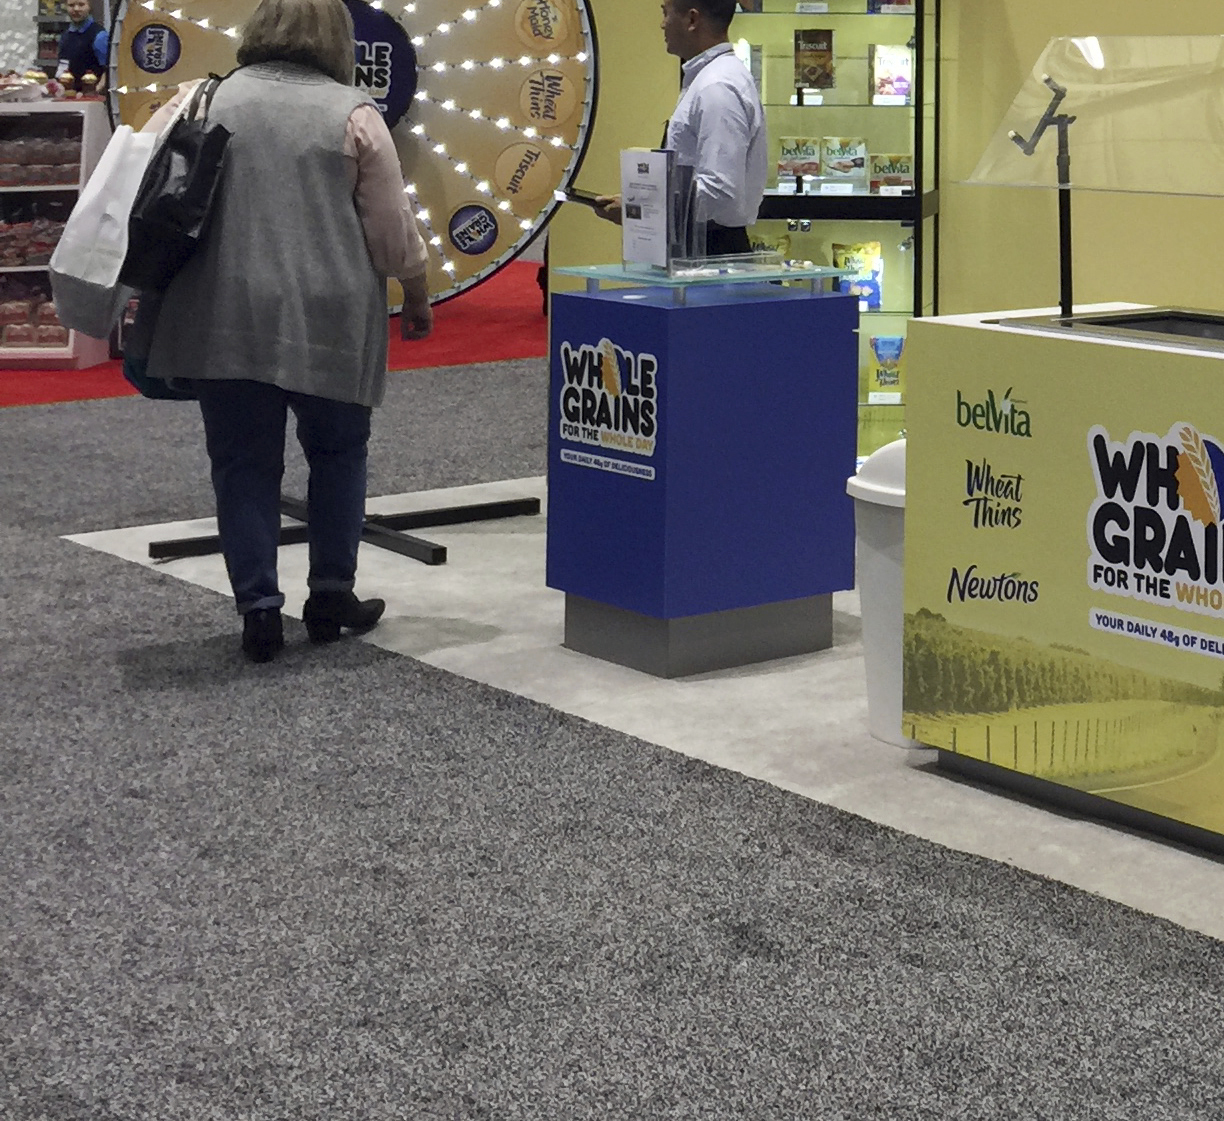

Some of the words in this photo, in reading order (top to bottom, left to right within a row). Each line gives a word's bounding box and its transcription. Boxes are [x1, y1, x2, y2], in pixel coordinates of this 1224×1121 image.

[529, 70, 546, 120] Thins
[542, 74, 564, 122] Wheat
[507, 149, 542, 195] Triscuit
[563, 388, 655, 438] GRAINS
[563, 423, 579, 437] FOR
[582, 427, 599, 441] THE
[601, 430, 633, 448] WHOLE
[635, 438, 653, 451] DAY
[965, 457, 1025, 502] Wheat
[962, 496, 1023, 529] Thins
[947, 564, 1039, 603] Newtons
[1093, 564, 1129, 590] FOR
[1133, 572, 1171, 599] THE
[1095, 613, 1125, 632] YOUR
[1127, 621, 1157, 638] DAILY
[1160, 629, 1180, 647] 48g
[1182, 634, 1197, 647] OF
